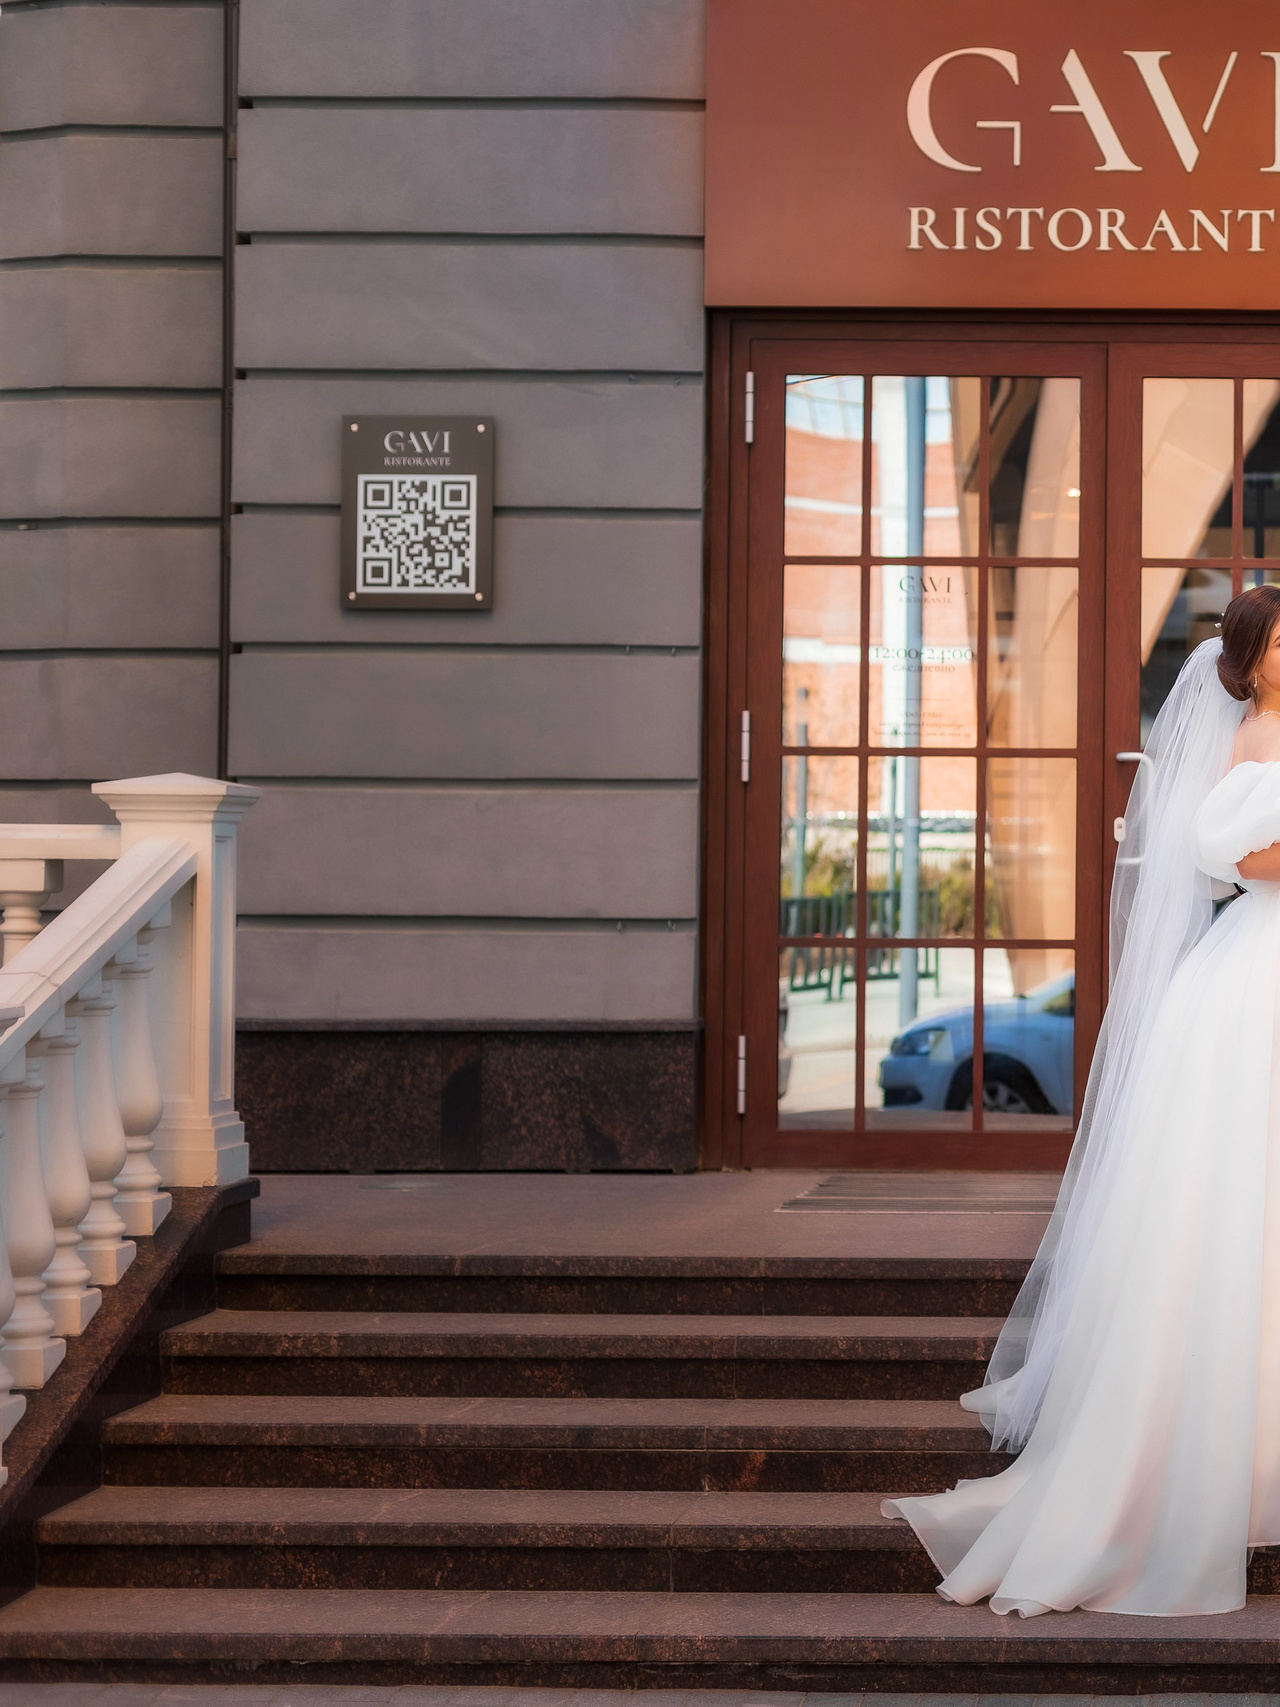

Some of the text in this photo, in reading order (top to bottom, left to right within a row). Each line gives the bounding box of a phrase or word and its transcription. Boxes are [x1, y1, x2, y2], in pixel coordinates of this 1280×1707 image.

[384, 430, 451, 454] GAVI
[384, 456, 451, 467] RISTORANTE
[899, 576, 951, 593] GAVI
